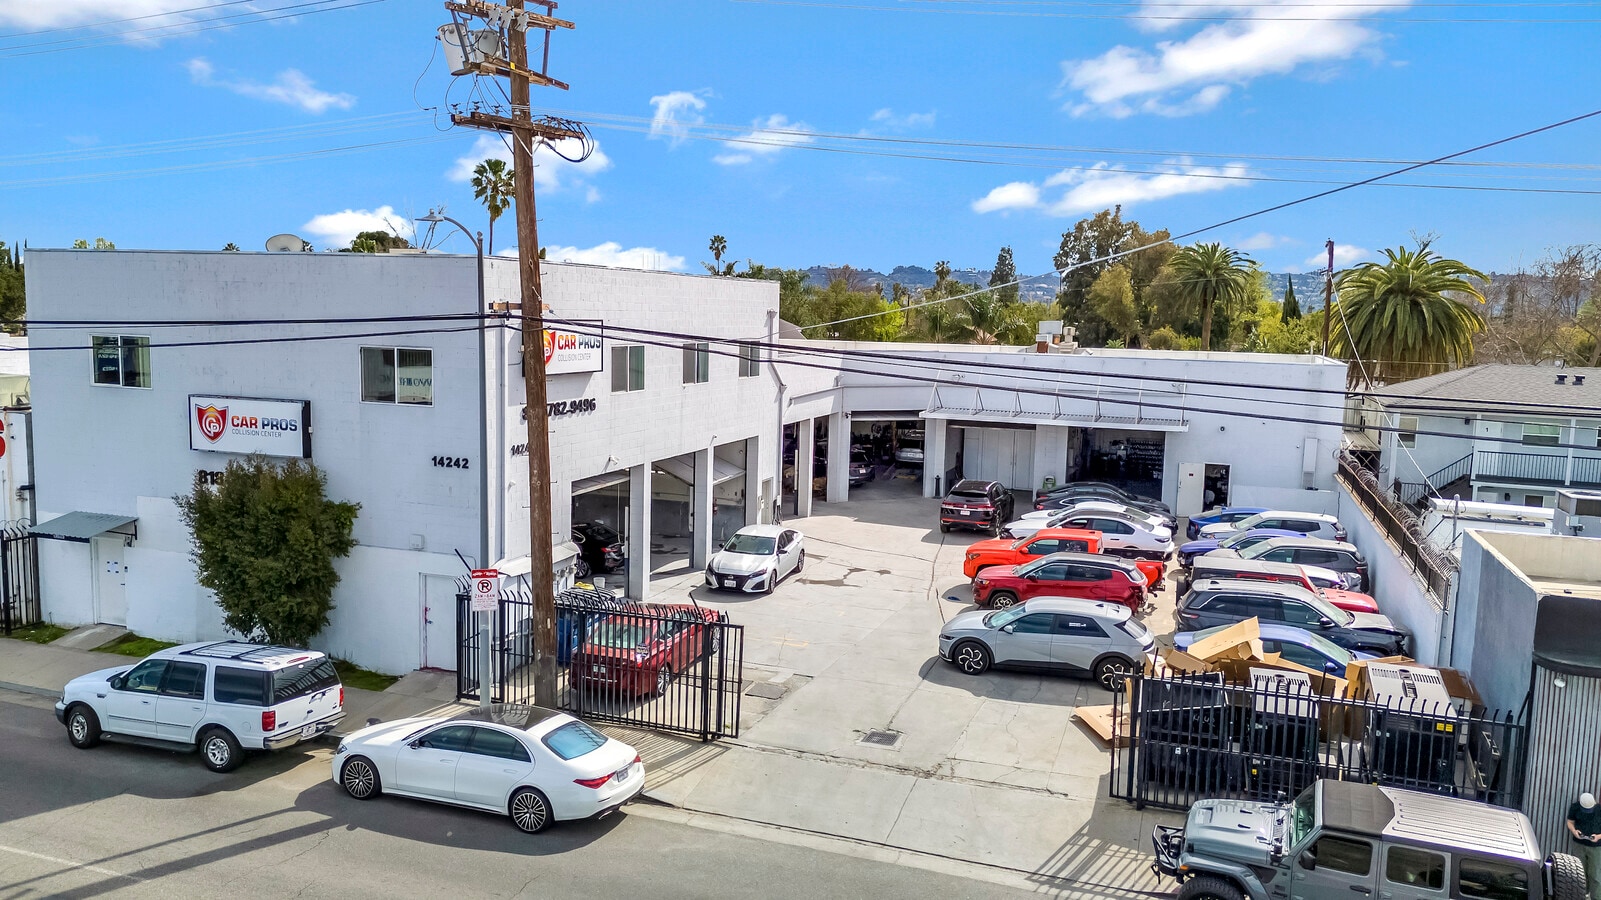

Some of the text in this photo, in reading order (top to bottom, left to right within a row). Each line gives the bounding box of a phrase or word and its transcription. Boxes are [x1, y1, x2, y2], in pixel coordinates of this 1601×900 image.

[557, 335, 600, 350] CAR PROS
[558, 352, 591, 362] COLLISION CENTER
[231, 416, 298, 431] CAR PROS
[232, 428, 282, 438] COLLISION CENTER
[432, 456, 469, 469] 14242
